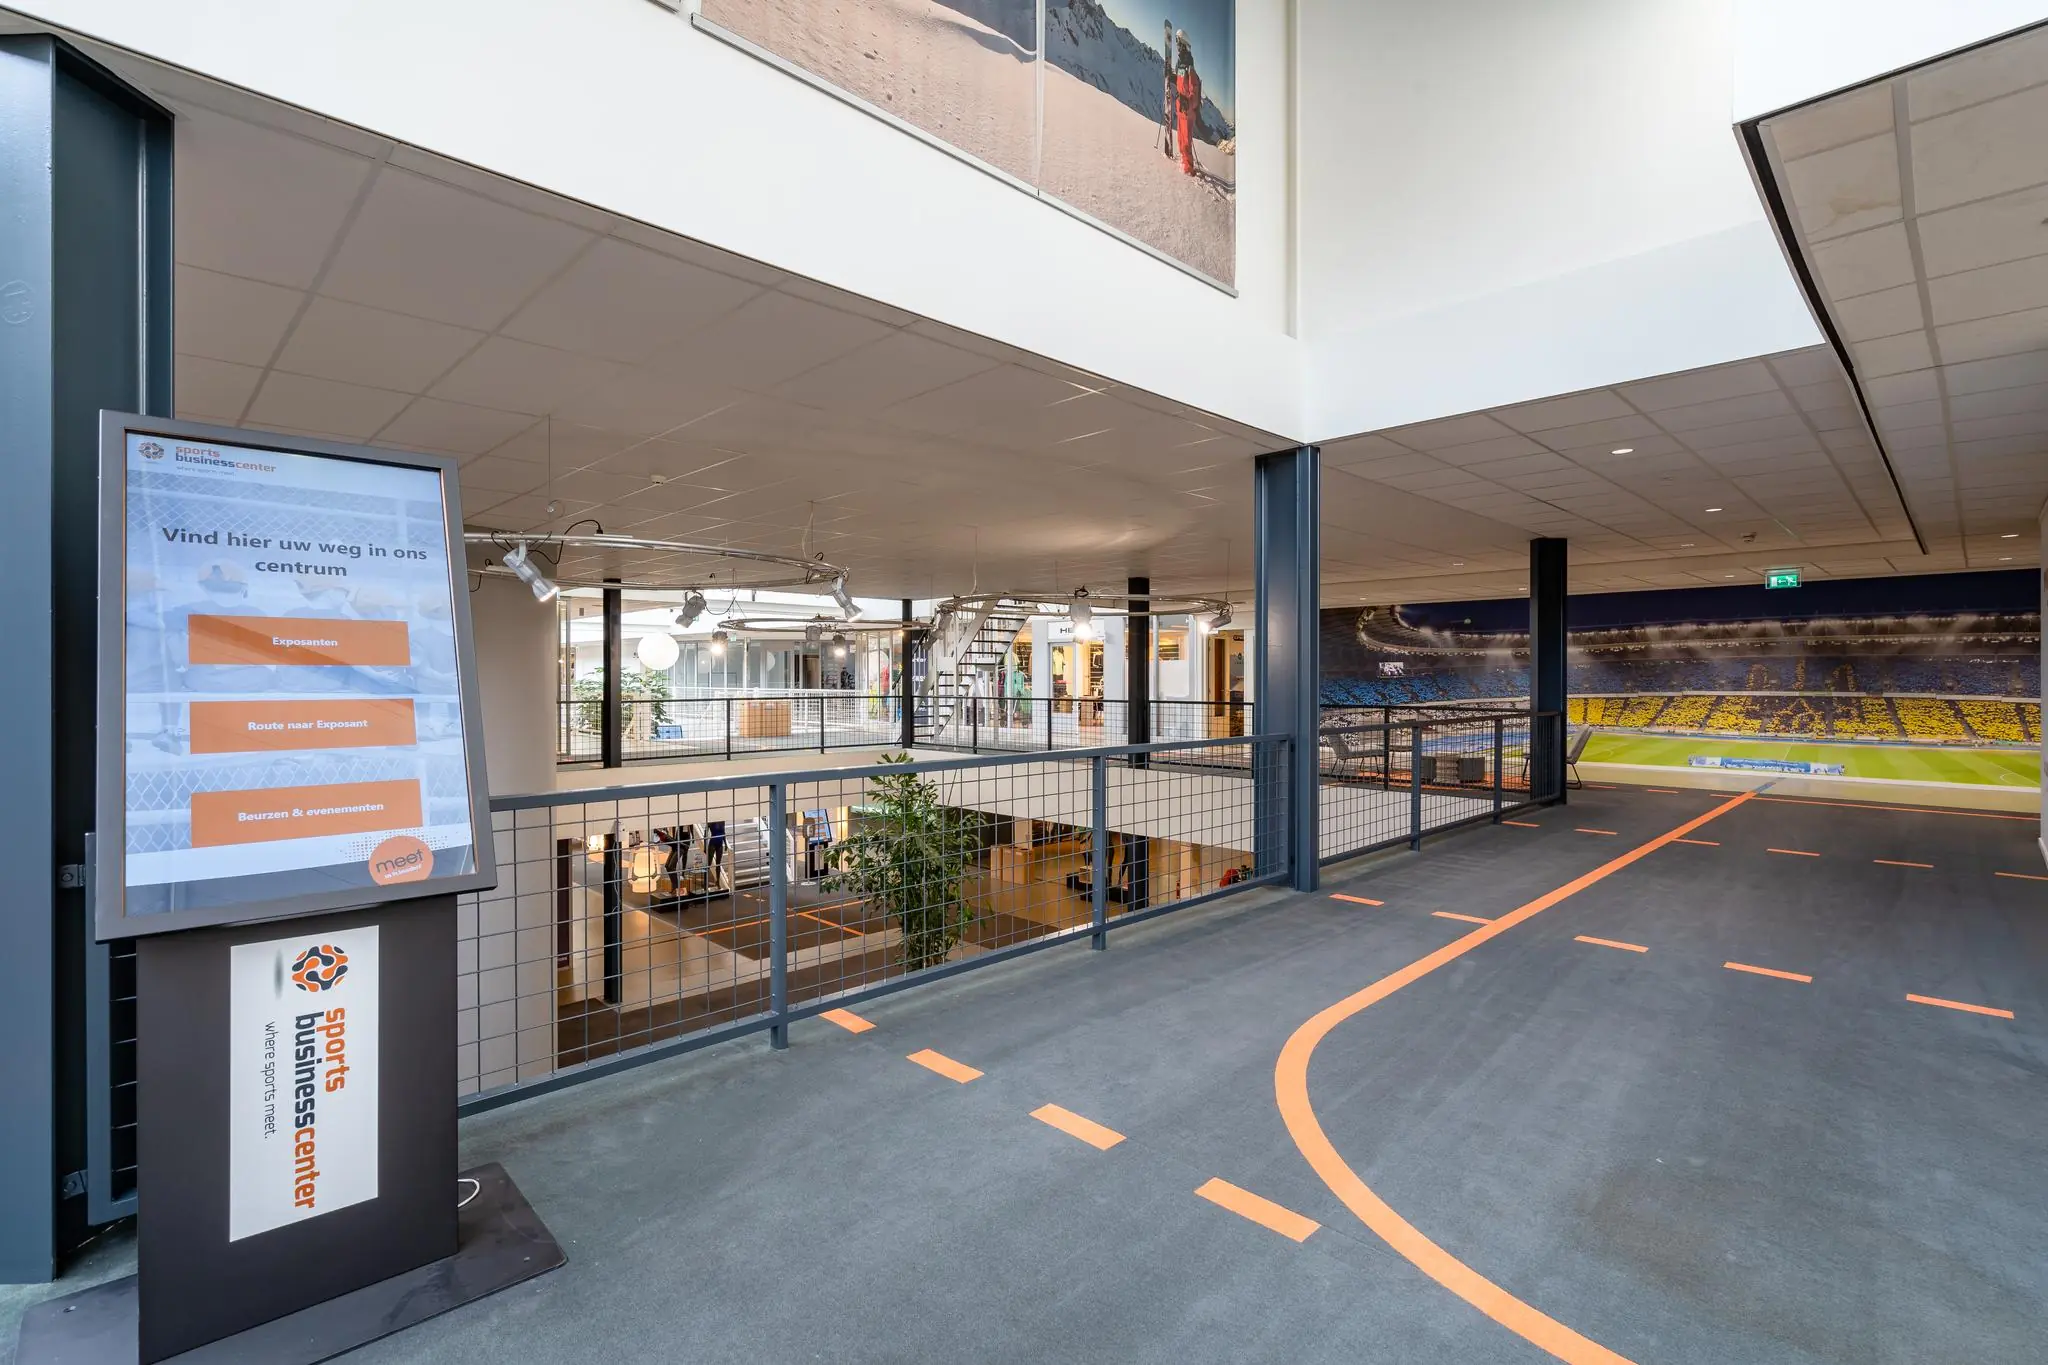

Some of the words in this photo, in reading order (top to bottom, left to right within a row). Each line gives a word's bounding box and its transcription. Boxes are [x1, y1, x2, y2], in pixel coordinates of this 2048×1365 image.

[176, 446, 220, 458] sports
[176, 452, 277, 472] businesscenter
[162, 527, 218, 545] Vind
[227, 532, 272, 548] hier
[279, 540, 312, 552] uw
[318, 543, 361, 559] weg
[368, 544, 387, 558] in
[393, 548, 427, 560] ons
[255, 561, 347, 577] centrum
[272, 636, 338, 648] Exposanten
[247, 721, 284, 731] Route
[287, 721, 314, 730] naar
[316, 719, 368, 730] Exposant
[238, 809, 289, 822] Beurzen
[292, 807, 304, 817] &
[306, 802, 384, 816] evenementen
[376, 848, 423, 873] meet
[264, 1021, 280, 1060] where
[316, 1007, 350, 1093] sports
[260, 1060, 276, 1102] sports
[264, 1102, 276, 1140] meet.
[294, 1011, 325, 1209] businesscenter
